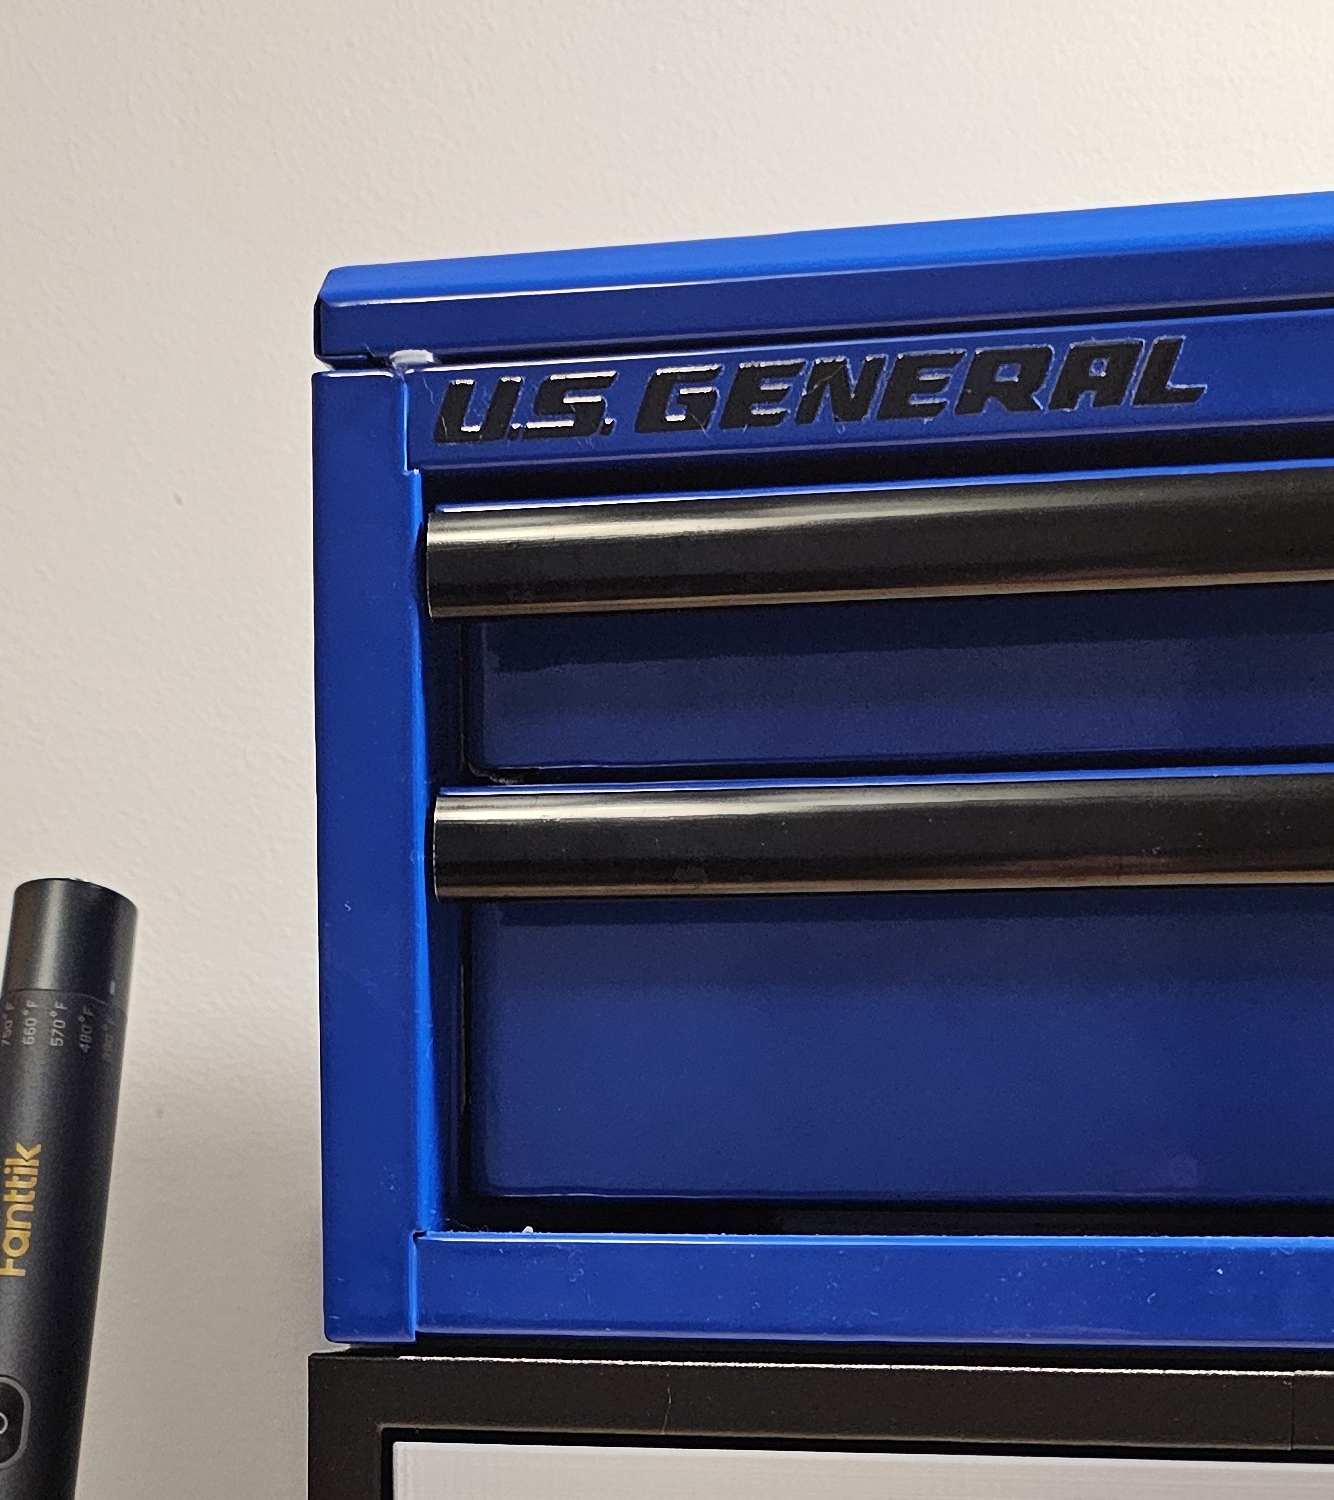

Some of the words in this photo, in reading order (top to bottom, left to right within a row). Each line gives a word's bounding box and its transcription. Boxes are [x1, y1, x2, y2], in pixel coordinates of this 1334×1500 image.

[433, 370, 619, 445] U.S.
[634, 335, 1208, 434] GENERAL
[48, 1000, 68, 1047] 570°F
